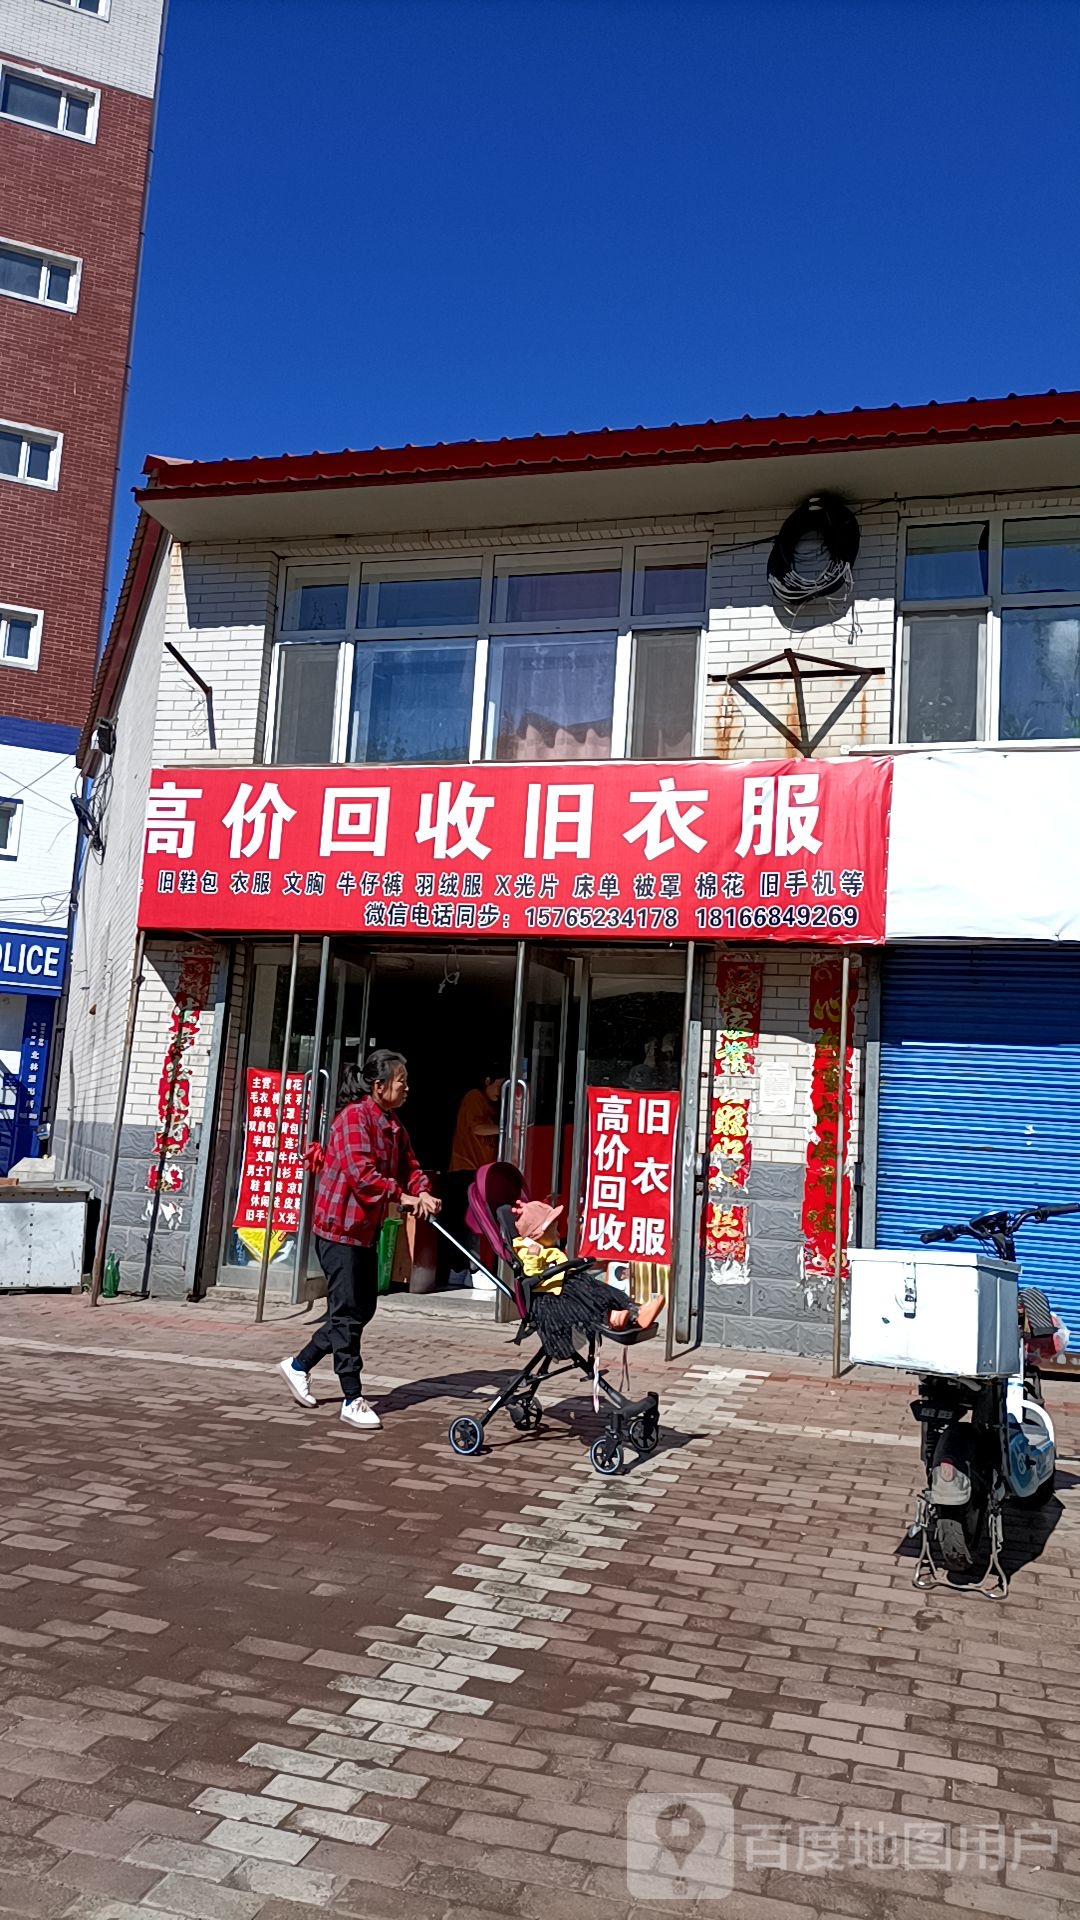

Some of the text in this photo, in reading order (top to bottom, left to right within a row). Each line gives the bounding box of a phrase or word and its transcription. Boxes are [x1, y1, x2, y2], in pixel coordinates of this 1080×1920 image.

[146, 774, 823, 861] 高价回收旧衣服
[158, 869, 865, 900] 旧鞋包 衣服 文胸 牛仔裤 羽绒服 X光片 床单 被罩 棉花 旧手机等
[525, 906, 679, 929] 15765234178
[695, 905, 859, 929] 18166849269
[588, 1094, 632, 1253] 高价回收
[628, 1097, 671, 1257] 旧衣服
